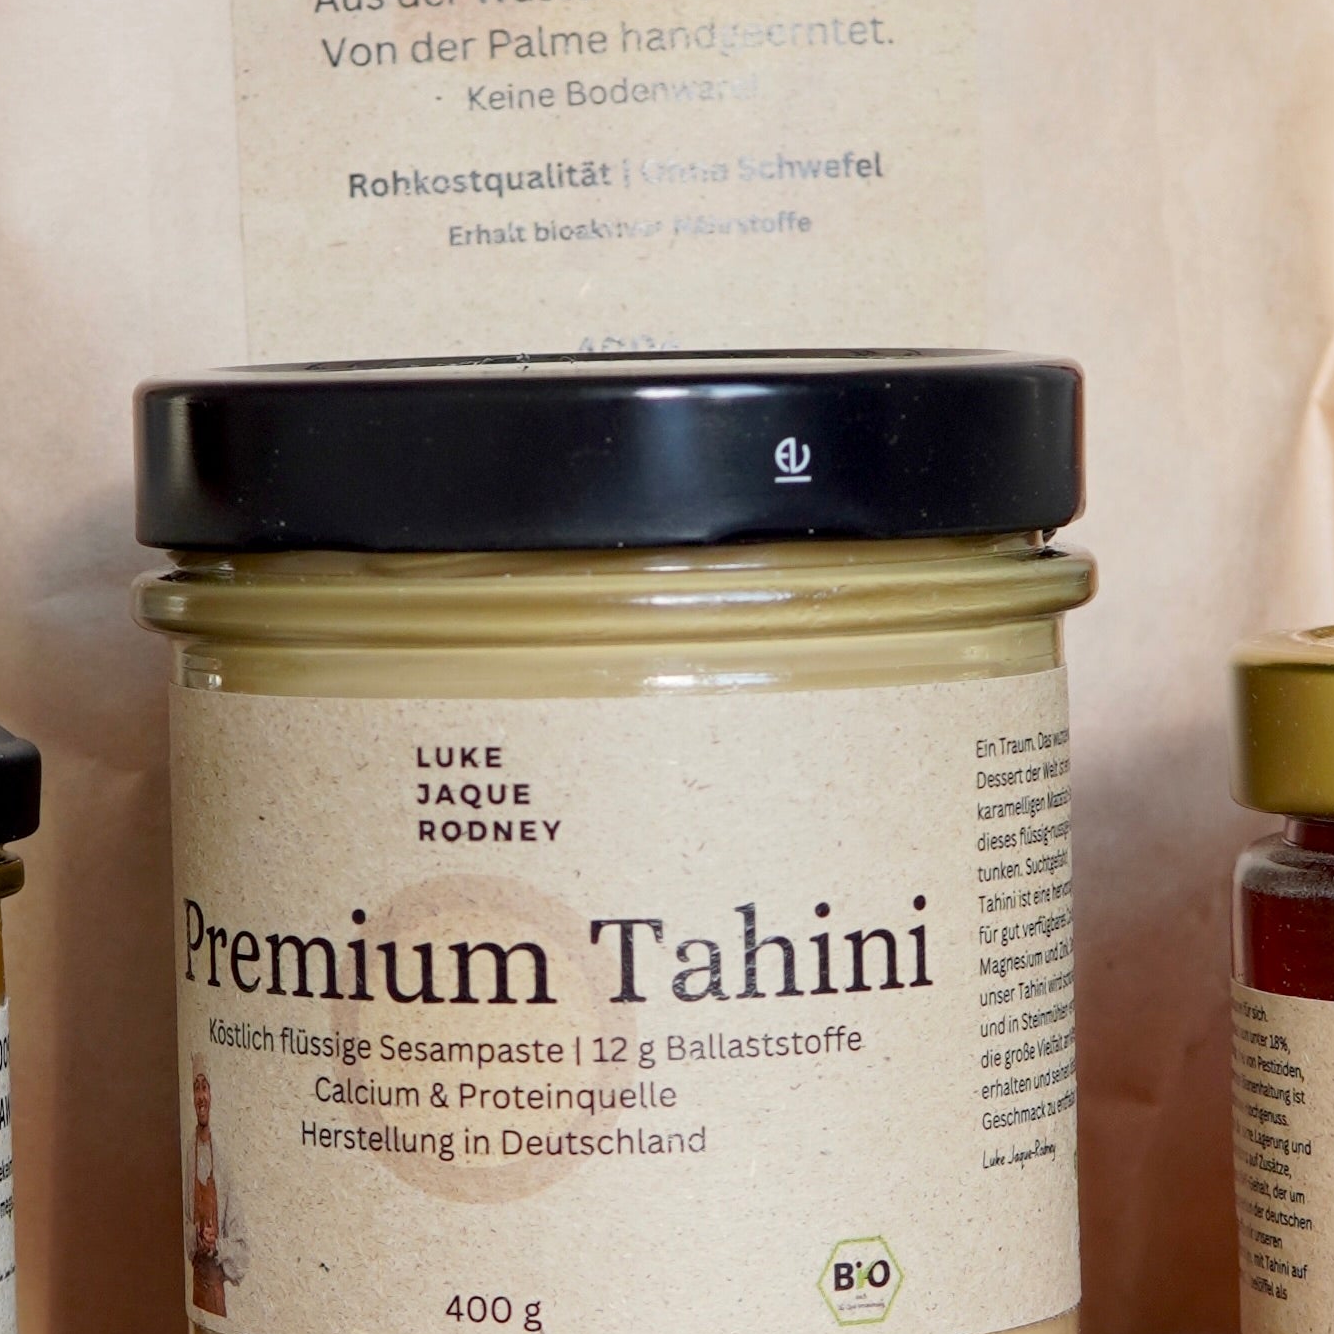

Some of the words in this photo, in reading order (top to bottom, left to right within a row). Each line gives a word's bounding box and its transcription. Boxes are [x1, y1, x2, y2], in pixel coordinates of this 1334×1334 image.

[322, 36, 397, 68] Von
[411, 31, 476, 63] der
[489, 26, 608, 60] Palme
[467, 83, 555, 111] Keine
[349, 160, 611, 198] Rohkostqualität
[738, 151, 882, 182] Schwefel
[449, 221, 525, 246] Erhalt
[417, 747, 502, 768] LUKE
[976, 739, 996, 758] Ein
[999, 737, 1036, 756] Traum.
[977, 768, 1023, 789] Dessert
[1026, 764, 1041, 782] der
[417, 783, 531, 809] JAQUE
[977, 795, 1045, 820] karamelligen
[418, 820, 561, 842] RODNEY
[977, 832, 1017, 851] dieses
[978, 861, 1023, 882] tunken.
[979, 890, 1016, 913] Tahini
[1019, 889, 1031, 907] ist
[1034, 886, 1050, 905] eine
[979, 925, 998, 945] für
[1001, 923, 1020, 946] gut
[184, 898, 558, 1004] Premium
[590, 895, 933, 1002] Tahini
[980, 950, 1043, 977] Magnesium
[980, 987, 1015, 1006] unser
[1018, 976, 1047, 1000] Tahini
[981, 1013, 1005, 1037] und
[1008, 1015, 1019, 1033] in
[209, 1017, 274, 1053] Köstlich
[280, 1027, 371, 1066] flüssige
[380, 1035, 563, 1068] Sesampaste
[592, 1037, 628, 1063] 12
[638, 1039, 656, 1068] g
[667, 1025, 863, 1061] Ballaststoffe
[981, 1048, 1001, 1068] die
[1005, 1042, 1035, 1070] große
[315, 1076, 419, 1107] Calcium
[430, 1082, 450, 1109] &
[459, 1081, 677, 1115] Proteinquelle
[982, 1077, 1031, 1099] erhalten
[1034, 1068, 1050, 1089] und
[1293, 1088, 1305, 1105] ist
[982, 1101, 1046, 1130] Geschmack
[301, 1121, 454, 1161] Herstellung
[464, 1127, 489, 1154] in
[502, 1126, 707, 1156] Deutschland
[1291, 1139, 1312, 1155] und
[983, 1148, 1005, 1169] Luke
[1272, 1183, 1287, 1201] der
[1290, 1189, 1305, 1204] um
[1265, 1207, 1312, 1230] deutschen
[1265, 1255, 1289, 1277] Tahini
[1292, 1264, 1308, 1279] auf
[1276, 1284, 1287, 1300] als
[446, 1294, 512, 1323] 400
[524, 1300, 542, 1332] g
